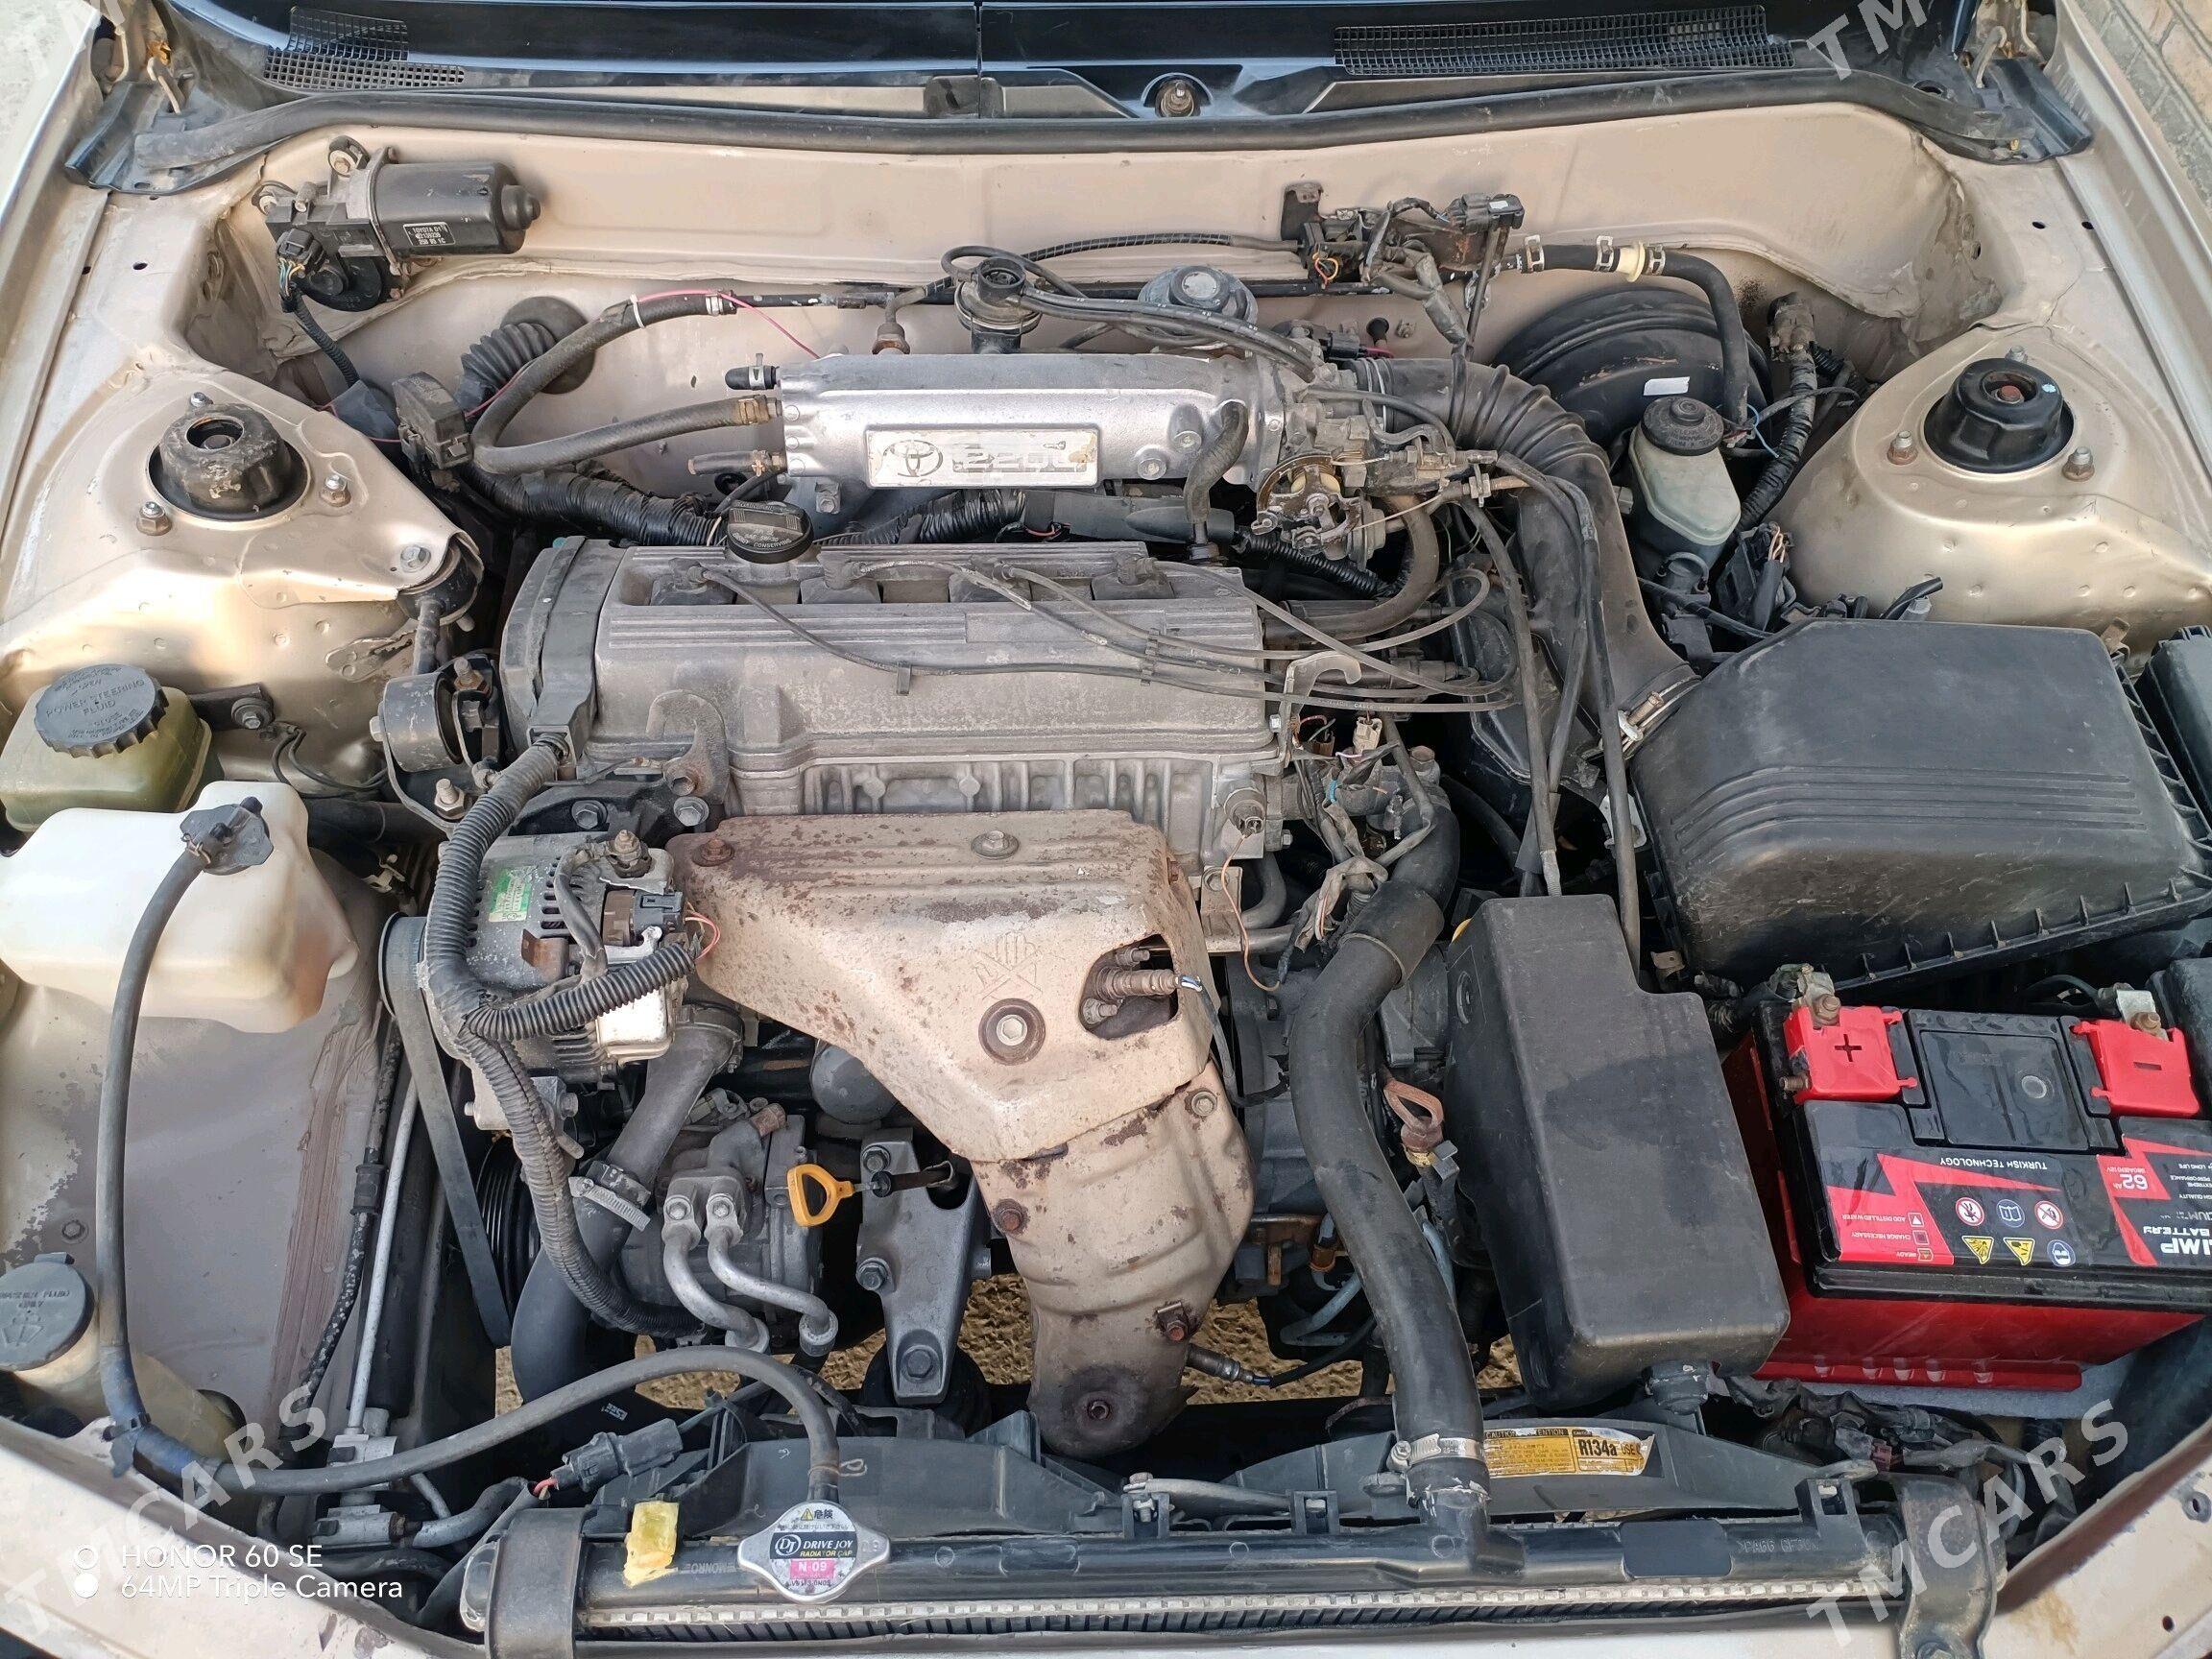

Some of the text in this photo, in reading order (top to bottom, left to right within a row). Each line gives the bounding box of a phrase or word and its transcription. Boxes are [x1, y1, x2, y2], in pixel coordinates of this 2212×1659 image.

[753, 539, 792, 548] CONSERVING
[46, 679, 145, 718] POWER STEERING
[83, 701, 116, 715] FLUID
[1939, 1157, 2048, 1170] TURKISH TECHNOLOGY
[2119, 1173, 2149, 1190] 62
[1850, 1231, 1886, 1239] NECESSARY
[2143, 1225, 2210, 1237] BATTERY
[1485, 1430, 1517, 1439] CAUTION
[1577, 1438, 1618, 1456] R134a
[1621, 1443, 1636, 1455] USE
[813, 1508, 834, 1520] 危険
[803, 1539, 854, 1550] DRIVE JOY
